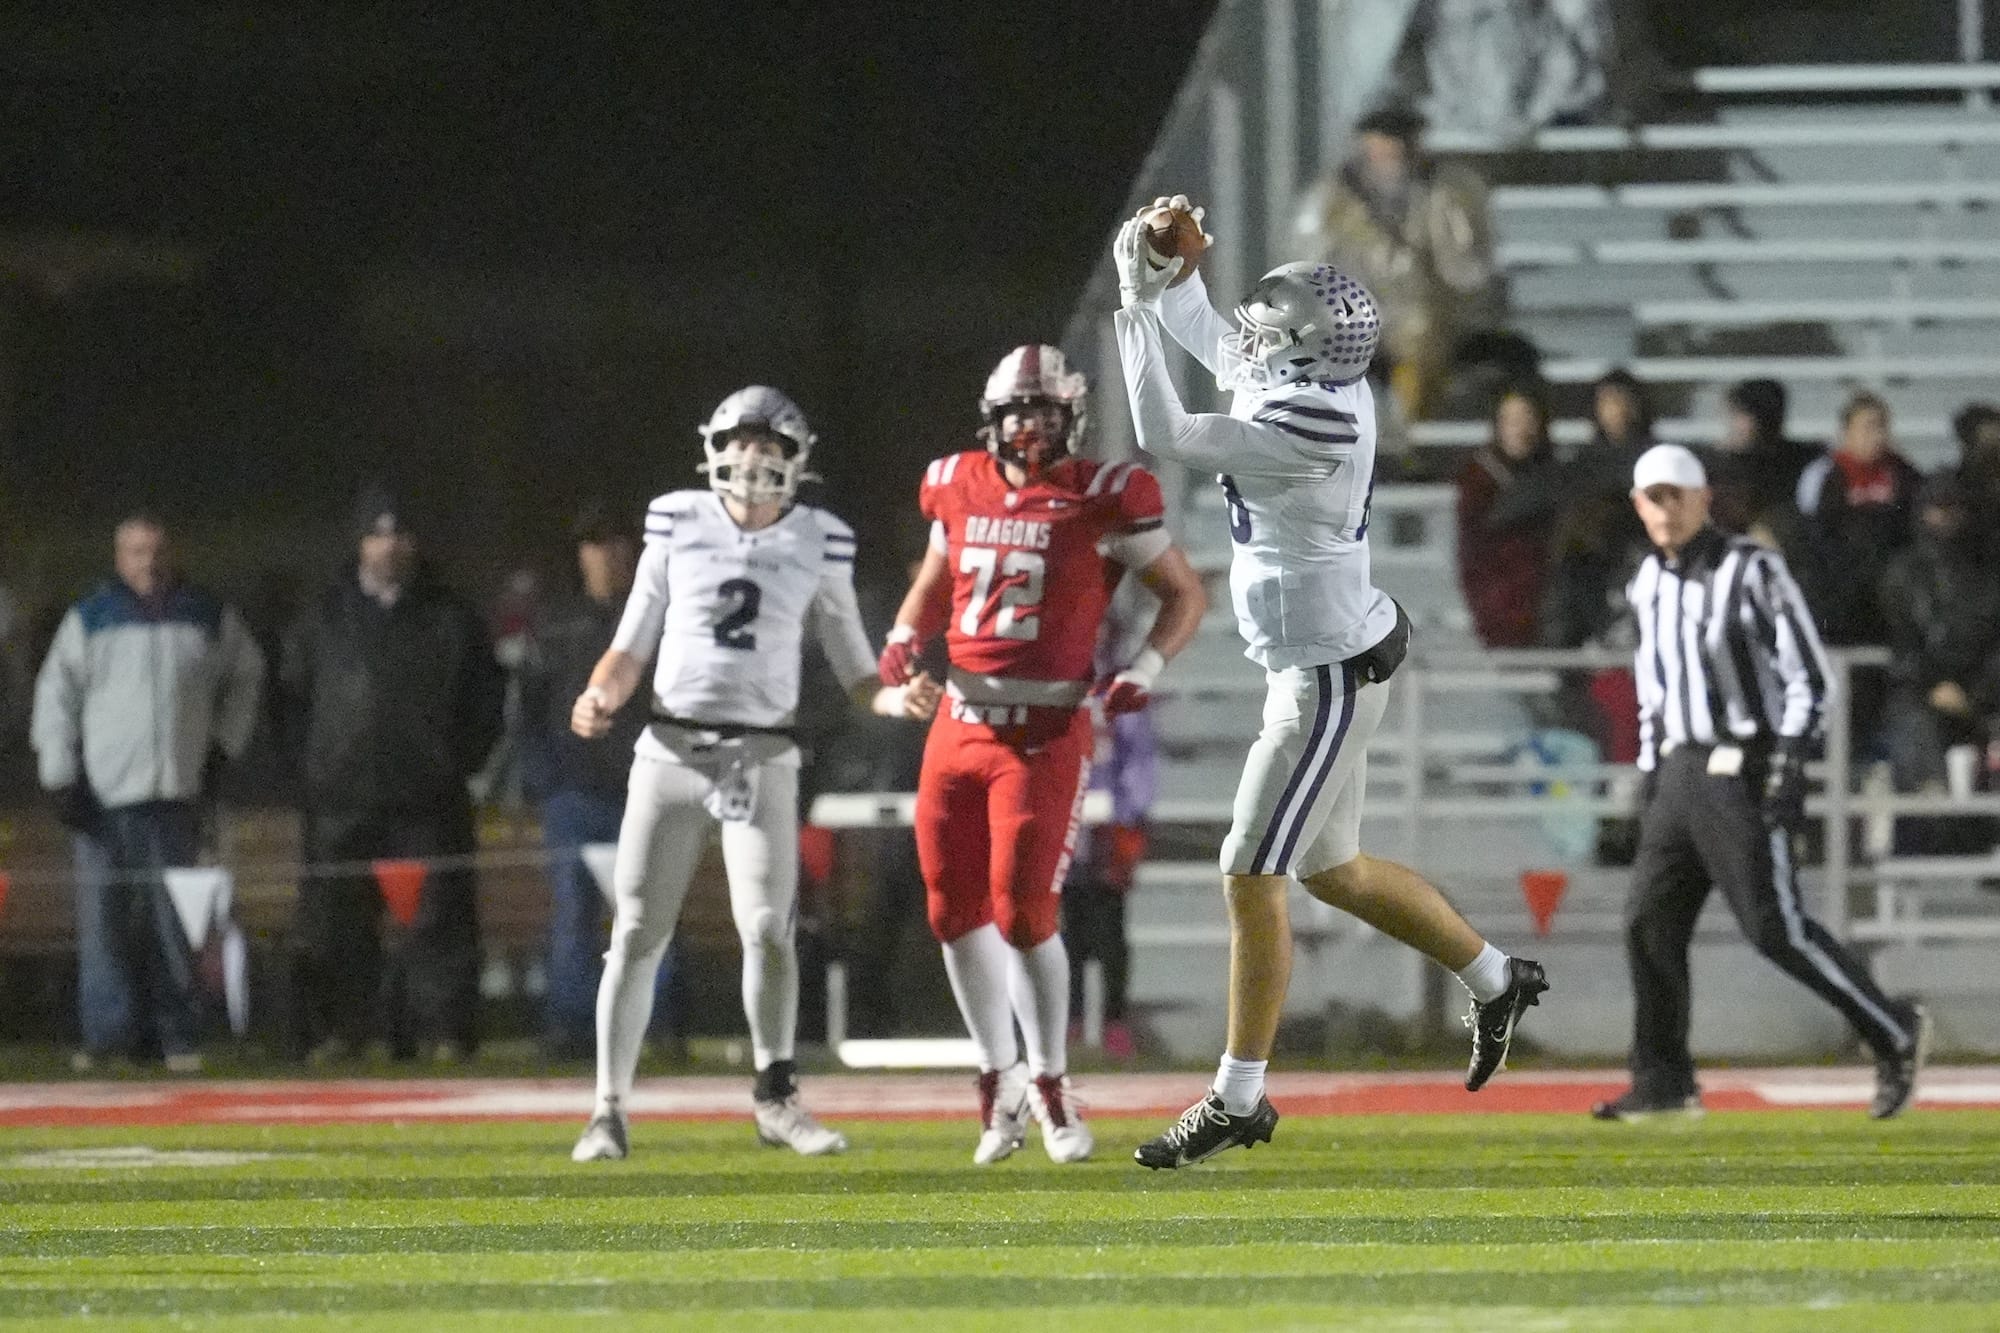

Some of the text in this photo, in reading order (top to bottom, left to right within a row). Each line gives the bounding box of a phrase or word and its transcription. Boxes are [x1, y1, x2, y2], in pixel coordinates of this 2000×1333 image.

[965, 516, 1052, 549] DRAGONS
[714, 579, 762, 651] 2
[960, 547, 1045, 640] 72
